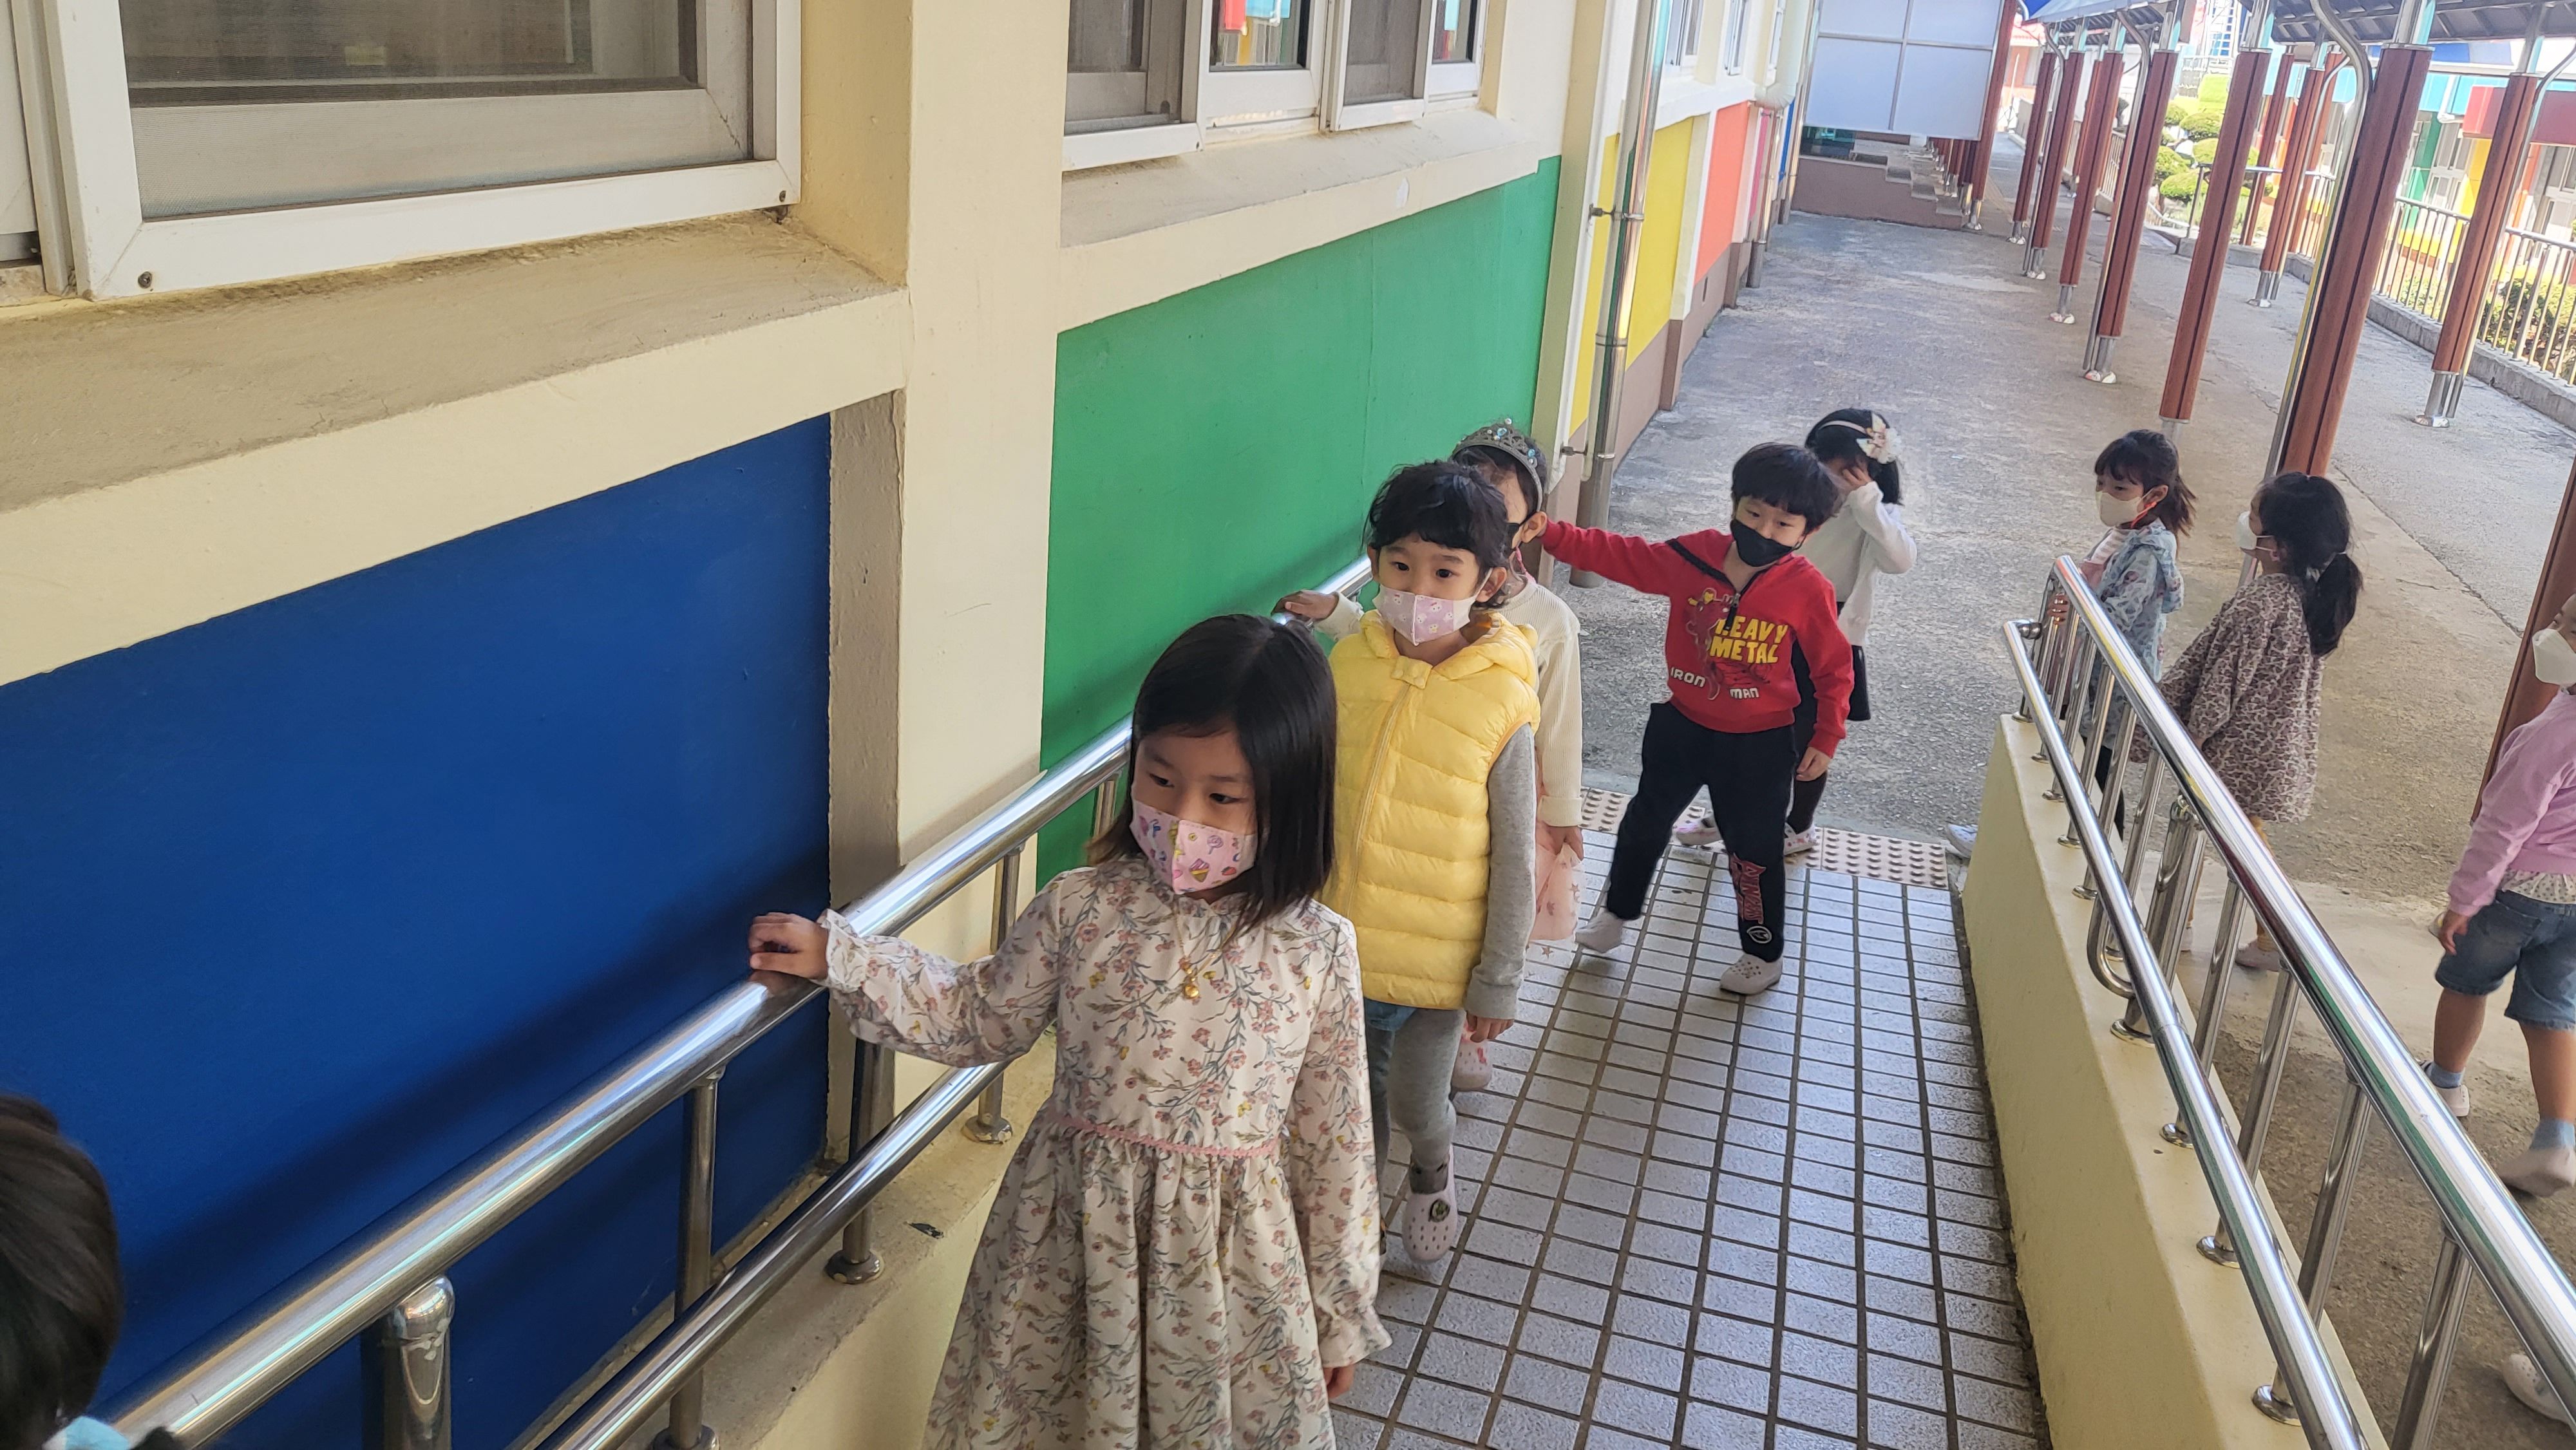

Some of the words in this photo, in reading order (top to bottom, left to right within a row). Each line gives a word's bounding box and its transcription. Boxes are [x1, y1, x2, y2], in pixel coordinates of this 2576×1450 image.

[1710, 636, 1778, 664] METAL
[1670, 666, 1705, 688] IRON
[1729, 687, 1759, 699] MAN
